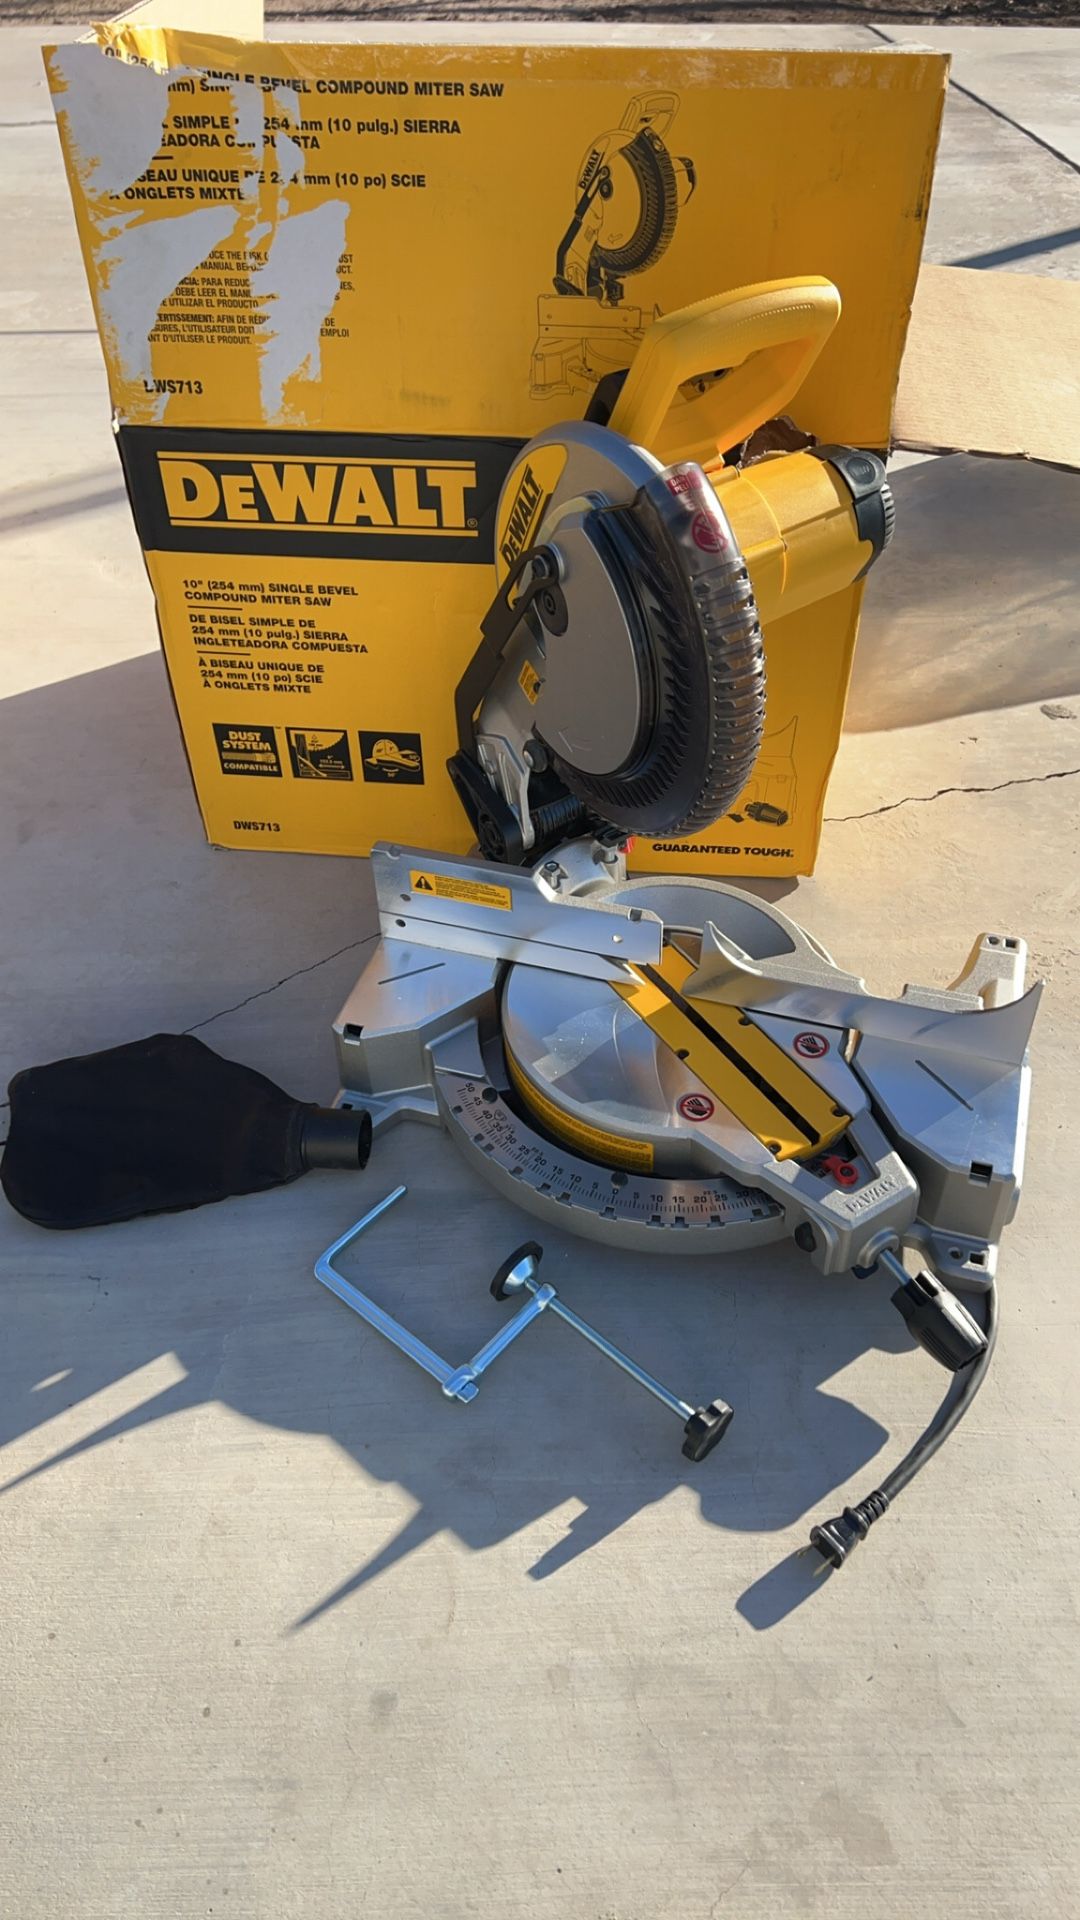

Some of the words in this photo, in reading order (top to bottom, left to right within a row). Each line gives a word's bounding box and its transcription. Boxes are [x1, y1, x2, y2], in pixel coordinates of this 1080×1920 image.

[316, 80, 409, 95] COMPOUND
[414, 82, 465, 96] MITER
[469, 83, 504, 97] SAW
[173, 116, 229, 129] SIMPLE
[328, 118, 351, 133] (10
[357, 119, 399, 135] pulg.)
[404, 120, 461, 134] SIERRA
[182, 170, 239, 182] UNIQUE
[335, 172, 358, 188] (10
[364, 174, 386, 189] po)
[391, 174, 426, 187] SCIE
[124, 187, 195, 199] ONGLETS
[227, 251, 242, 260] THE
[201, 278, 221, 286] PARA
[175, 288, 196, 296] DEBE
[198, 288, 217, 297] LEER
[219, 289, 228, 297] EL
[169, 298, 203, 308] UTILIZAR
[206, 299, 215, 308] EL
[217, 315, 234, 324] AFIN
[236, 315, 246, 324] DE
[324, 317, 335, 327] DE
[206, 335, 215, 344] LE
[217, 335, 252, 345] PRODUIT.
[182, 580, 203, 588] 10"
[207, 580, 234, 591] (254
[238, 583, 265, 593] mm)
[268, 583, 314, 594] SINGLE
[318, 585, 358, 596] BEVEL
[184, 591, 257, 603] COMPOUND
[261, 595, 301, 605] MITER
[305, 596, 332, 607] SAW
[189, 614, 206, 623] DE
[210, 615, 245, 625] BISEL
[249, 617, 295, 627] SIMPLE
[299, 619, 316, 628] DE
[192, 625, 214, 635] 254
[218, 629, 240, 637] mm
[244, 628, 262, 638] (10
[266, 630, 300, 641] pulg.)
[303, 630, 348, 642] SIERRA
[193, 637, 288, 650] INGLETEADORA
[292, 641, 368, 653] COMPUESTA
[199, 656, 206, 667] À
[210, 659, 254, 669] BISEAU
[257, 661, 304, 672] UNIQUE
[307, 664, 325, 673] DE
[201, 669, 223, 678] 254
[226, 672, 248, 680] mm
[251, 672, 270, 682] (10
[274, 673, 292, 683] po)
[295, 674, 323, 684] SCIE
[203, 678, 211, 688] À
[214, 680, 270, 692] ONGLETS
[273, 683, 311, 693] MIXTE
[228, 731, 261, 741] DUST
[222, 740, 271, 751] SYSTEM
[223, 762, 278, 772] COMPATIBLE
[233, 820, 281, 832] DWS713
[652, 843, 740, 855] GUARANTEED
[465, 1082, 475, 1092] 50
[473, 1096, 482, 1106] 45
[482, 1110, 492, 1119] 40
[505, 1134, 517, 1144] 30
[518, 1144, 530, 1155] 25
[534, 1155, 547, 1166] 20
[552, 1165, 564, 1174] 15
[569, 1174, 582, 1183] 10
[693, 1195, 707, 1203] 20
[735, 1191, 749, 1199] 30
